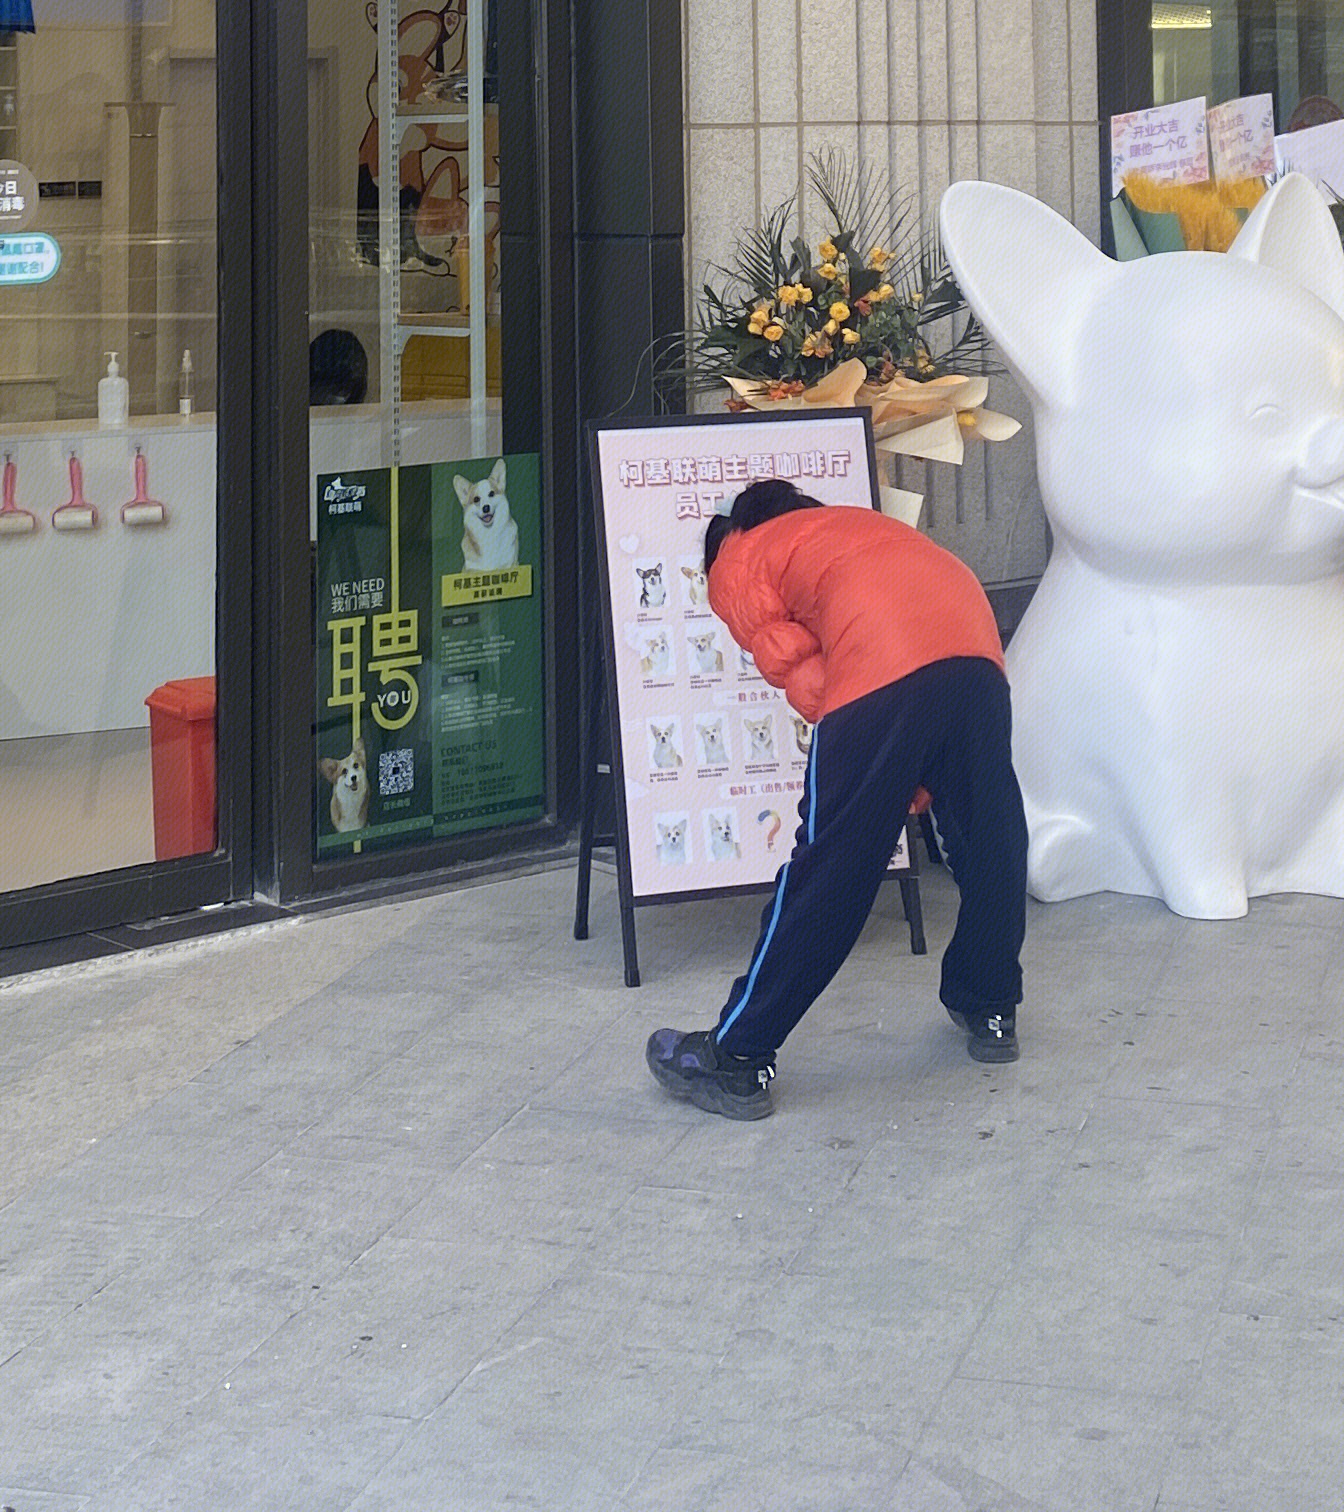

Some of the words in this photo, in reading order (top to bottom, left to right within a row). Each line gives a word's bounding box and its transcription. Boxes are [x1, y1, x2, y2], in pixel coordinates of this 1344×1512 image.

[1133, 118, 1179, 139] 开业大吉
[618, 449, 851, 488] 柯基联萌主题咖啡厅
[676, 489, 738, 520] 员工
[331, 582, 350, 597] WE
[352, 578, 385, 595] NEED
[331, 591, 384, 614] 我们需要
[377, 690, 412, 708] YOU
